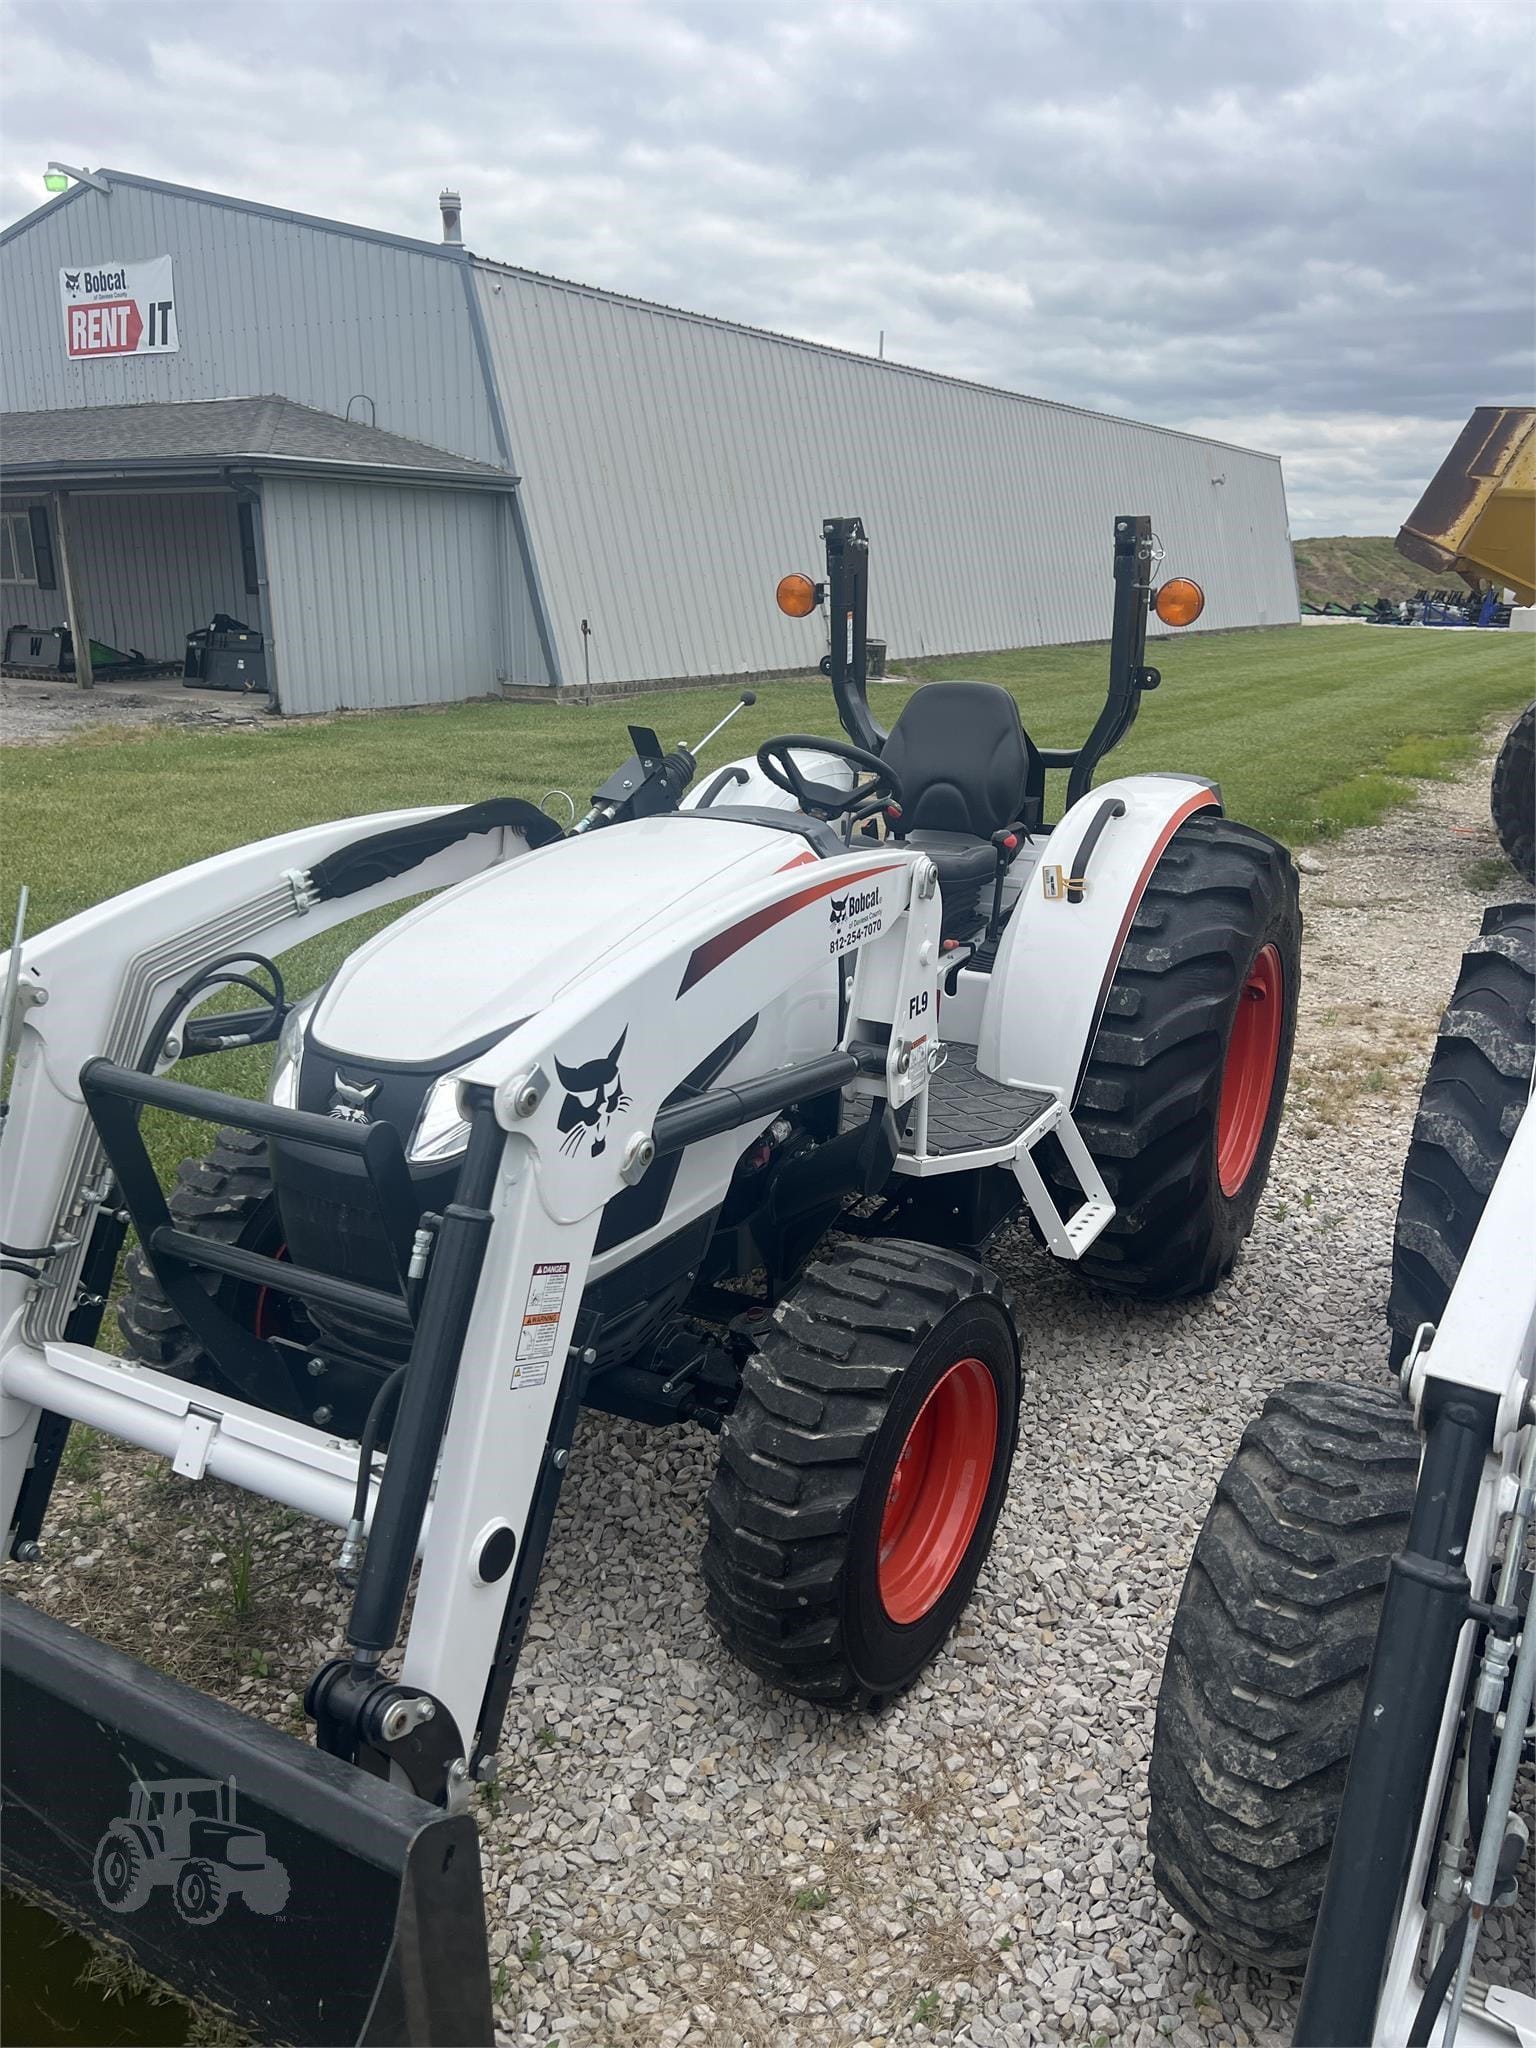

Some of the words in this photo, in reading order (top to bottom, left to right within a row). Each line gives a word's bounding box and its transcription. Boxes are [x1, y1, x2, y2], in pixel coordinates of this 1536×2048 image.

[84, 269, 126, 293] Bobcat
[72, 306, 131, 350] RENT
[149, 301, 172, 346] IT
[849, 886, 879, 917] Bobcat
[829, 919, 882, 954] 812-254-7070
[909, 991, 928, 1020] FL9
[543, 1264, 567, 1274] DANGER
[532, 1314, 557, 1323] WARNING
